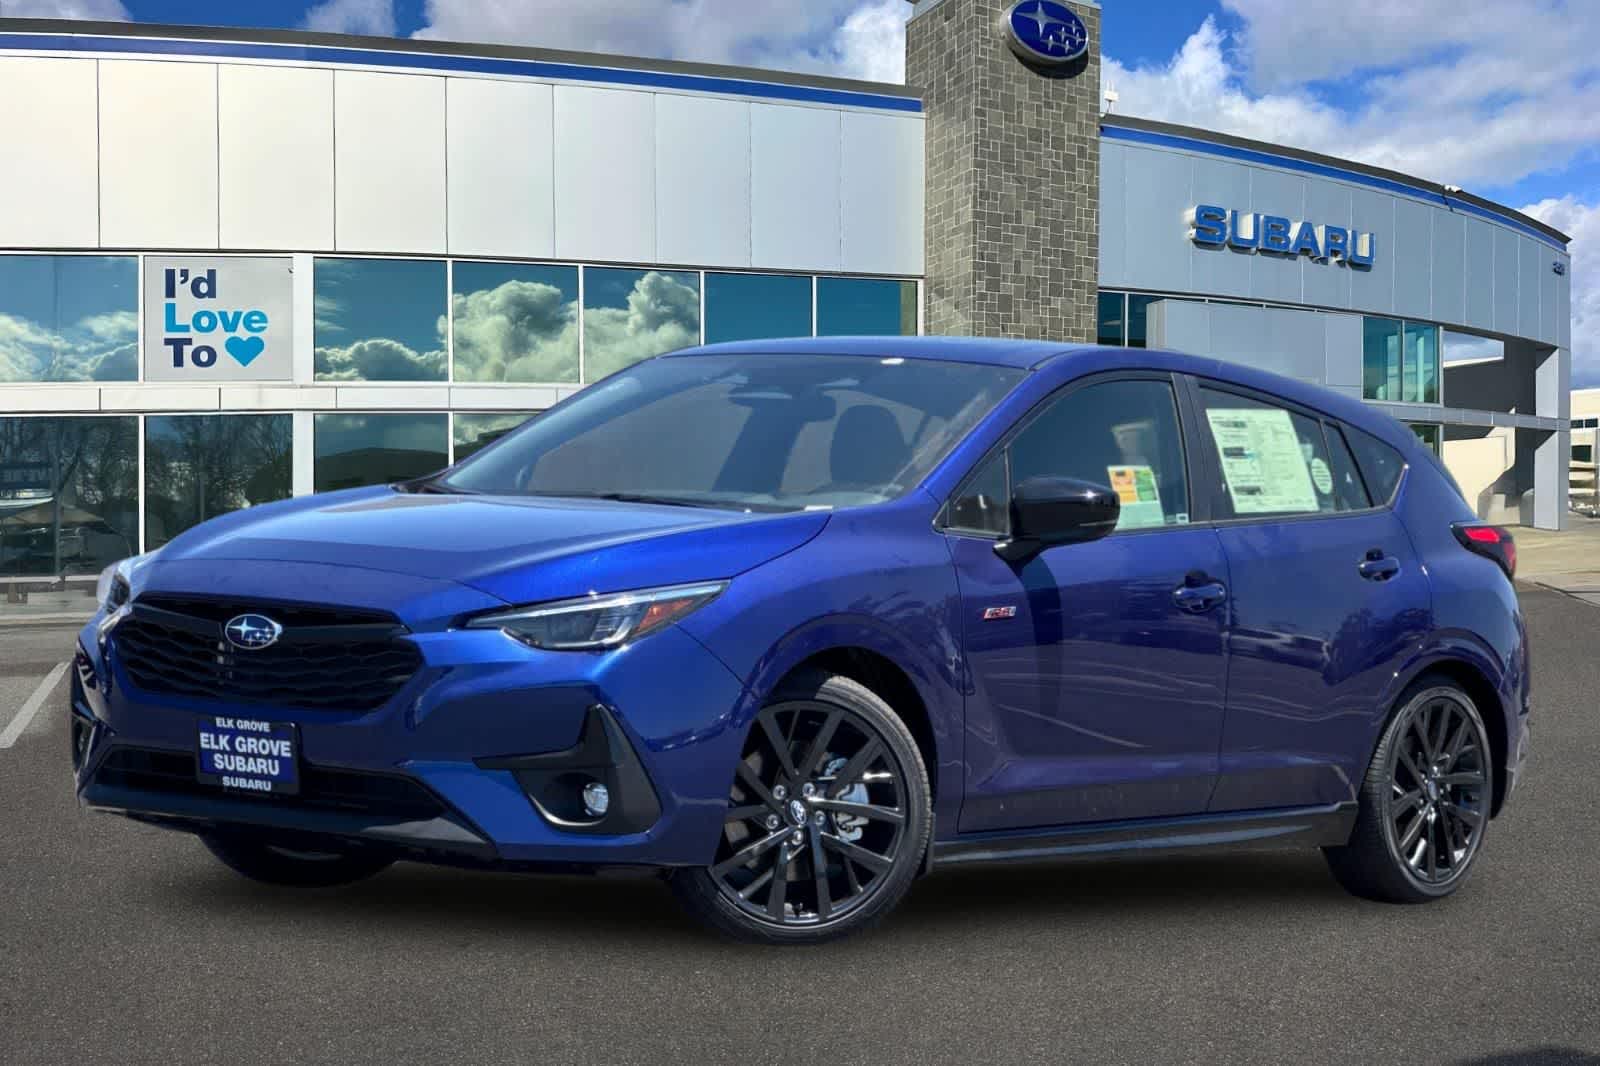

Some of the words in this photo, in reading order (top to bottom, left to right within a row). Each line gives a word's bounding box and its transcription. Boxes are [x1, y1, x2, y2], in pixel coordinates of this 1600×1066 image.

[1192, 204, 1375, 271] SUBARU
[165, 303, 268, 333] Love
[164, 338, 217, 368] To
[216, 717, 234, 728] ELK
[237, 720, 270, 732] GROVE
[200, 732, 230, 751] ELK
[235, 735, 291, 757] GROVE
[214, 753, 279, 775] SUBARU
[223, 776, 271, 791] SUBARU
